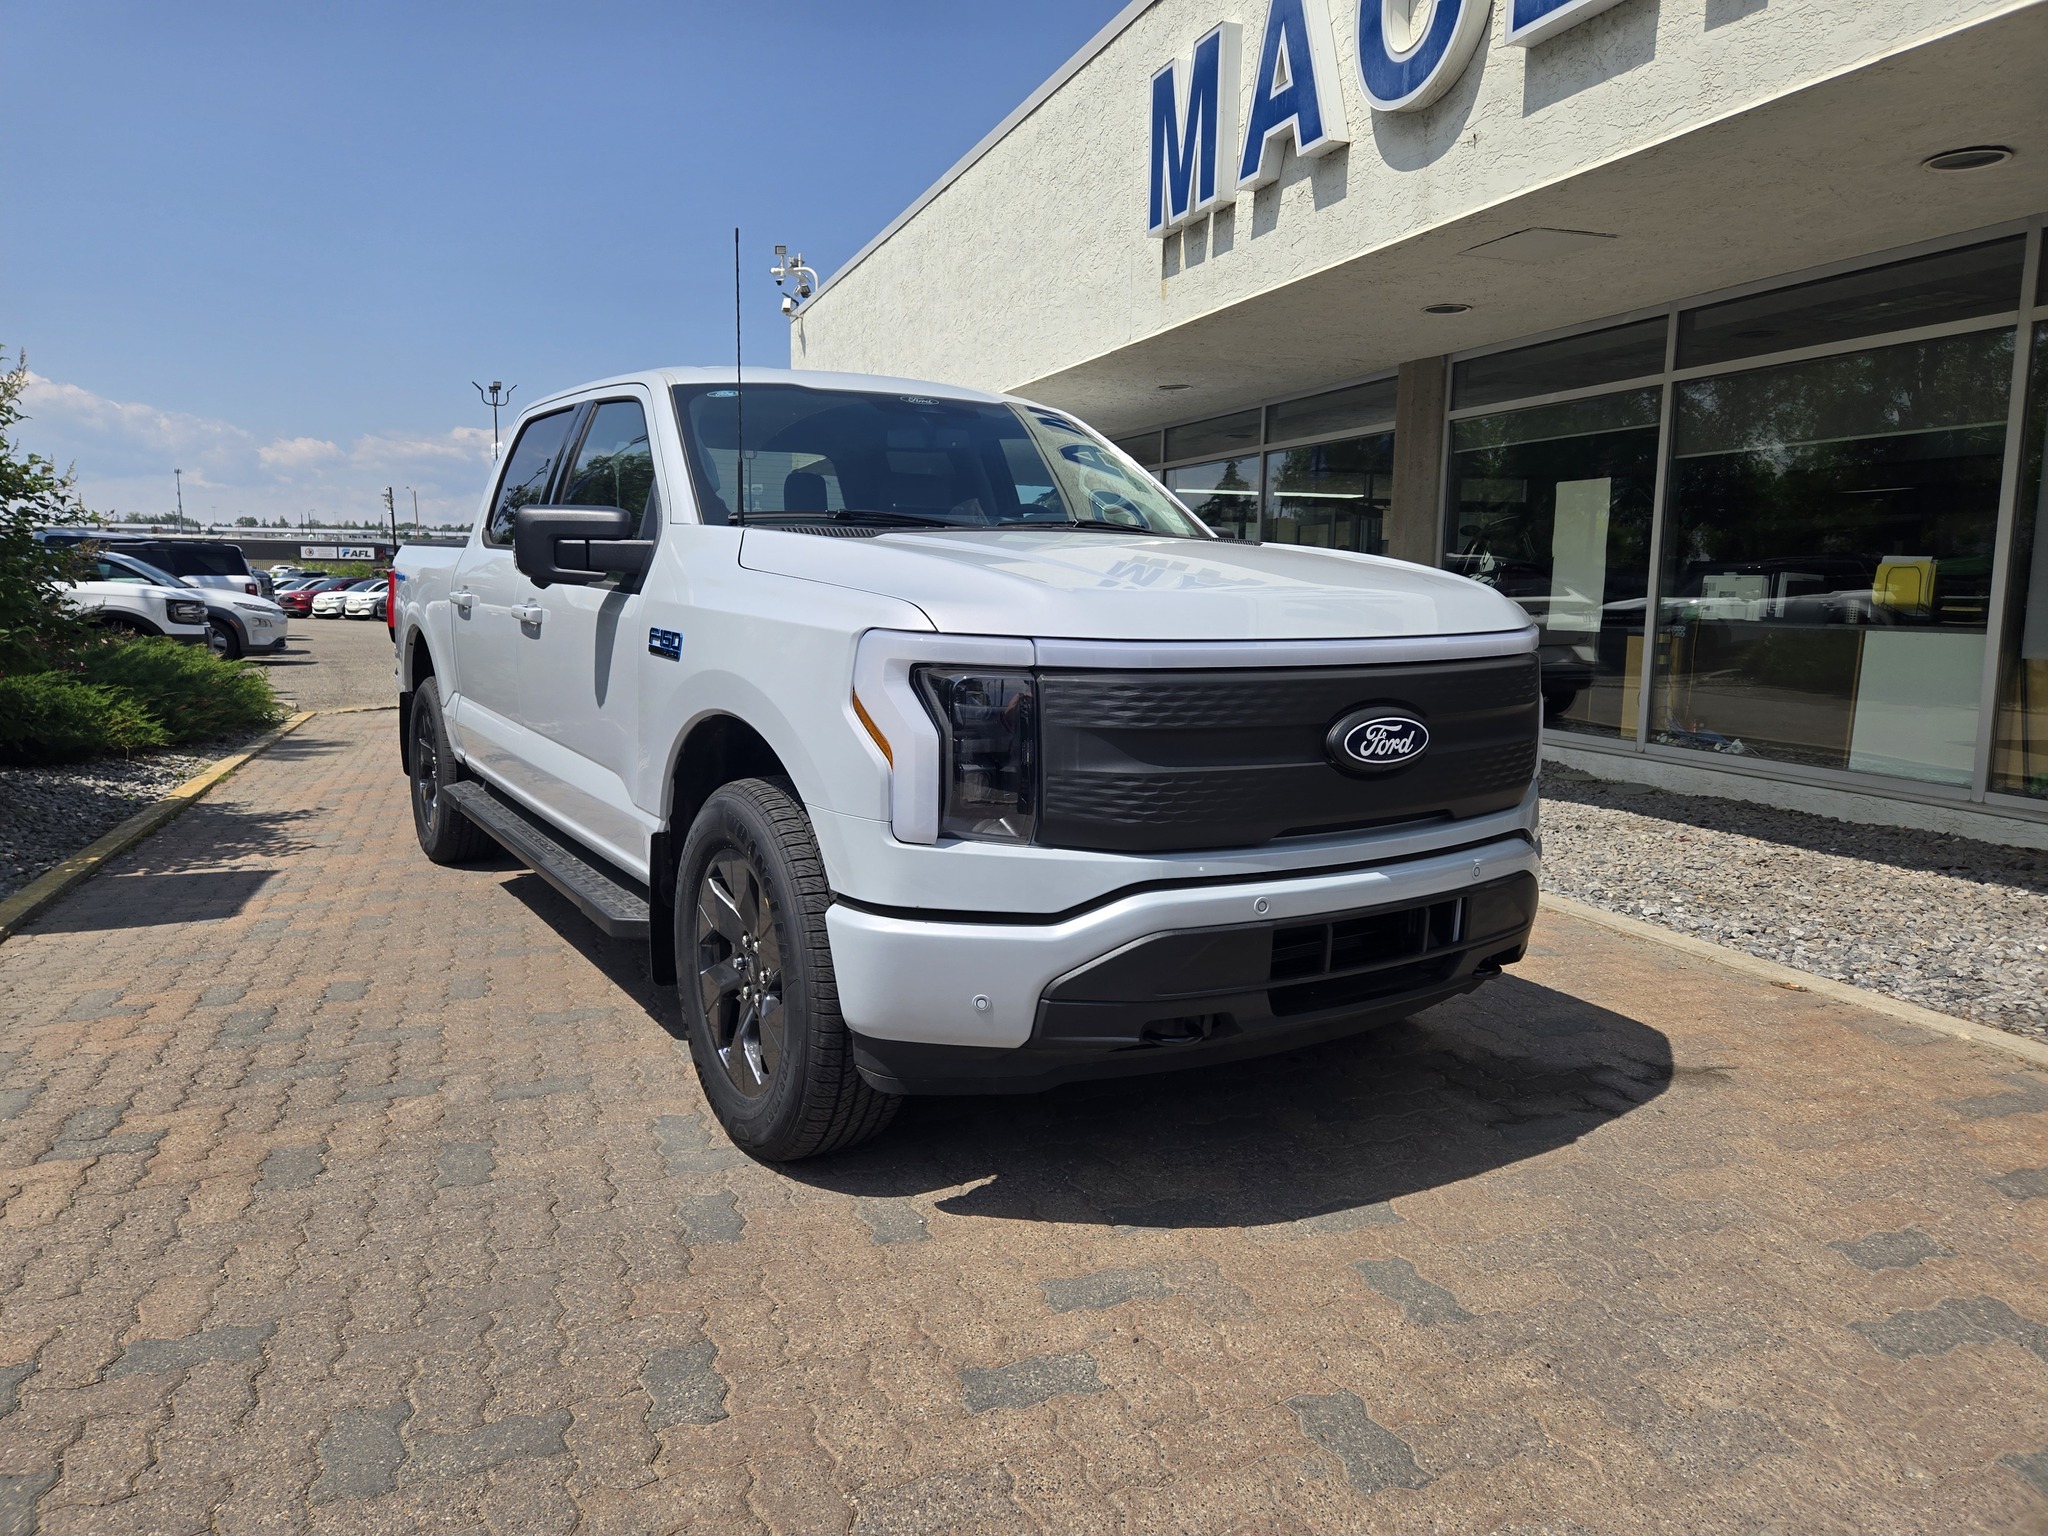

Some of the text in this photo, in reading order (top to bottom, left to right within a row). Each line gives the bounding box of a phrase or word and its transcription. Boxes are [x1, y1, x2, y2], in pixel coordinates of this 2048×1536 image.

[1147, 0, 1606, 238] MA
[350, 550, 371, 558] AFL
[1360, 724, 1415, 757] Ford
